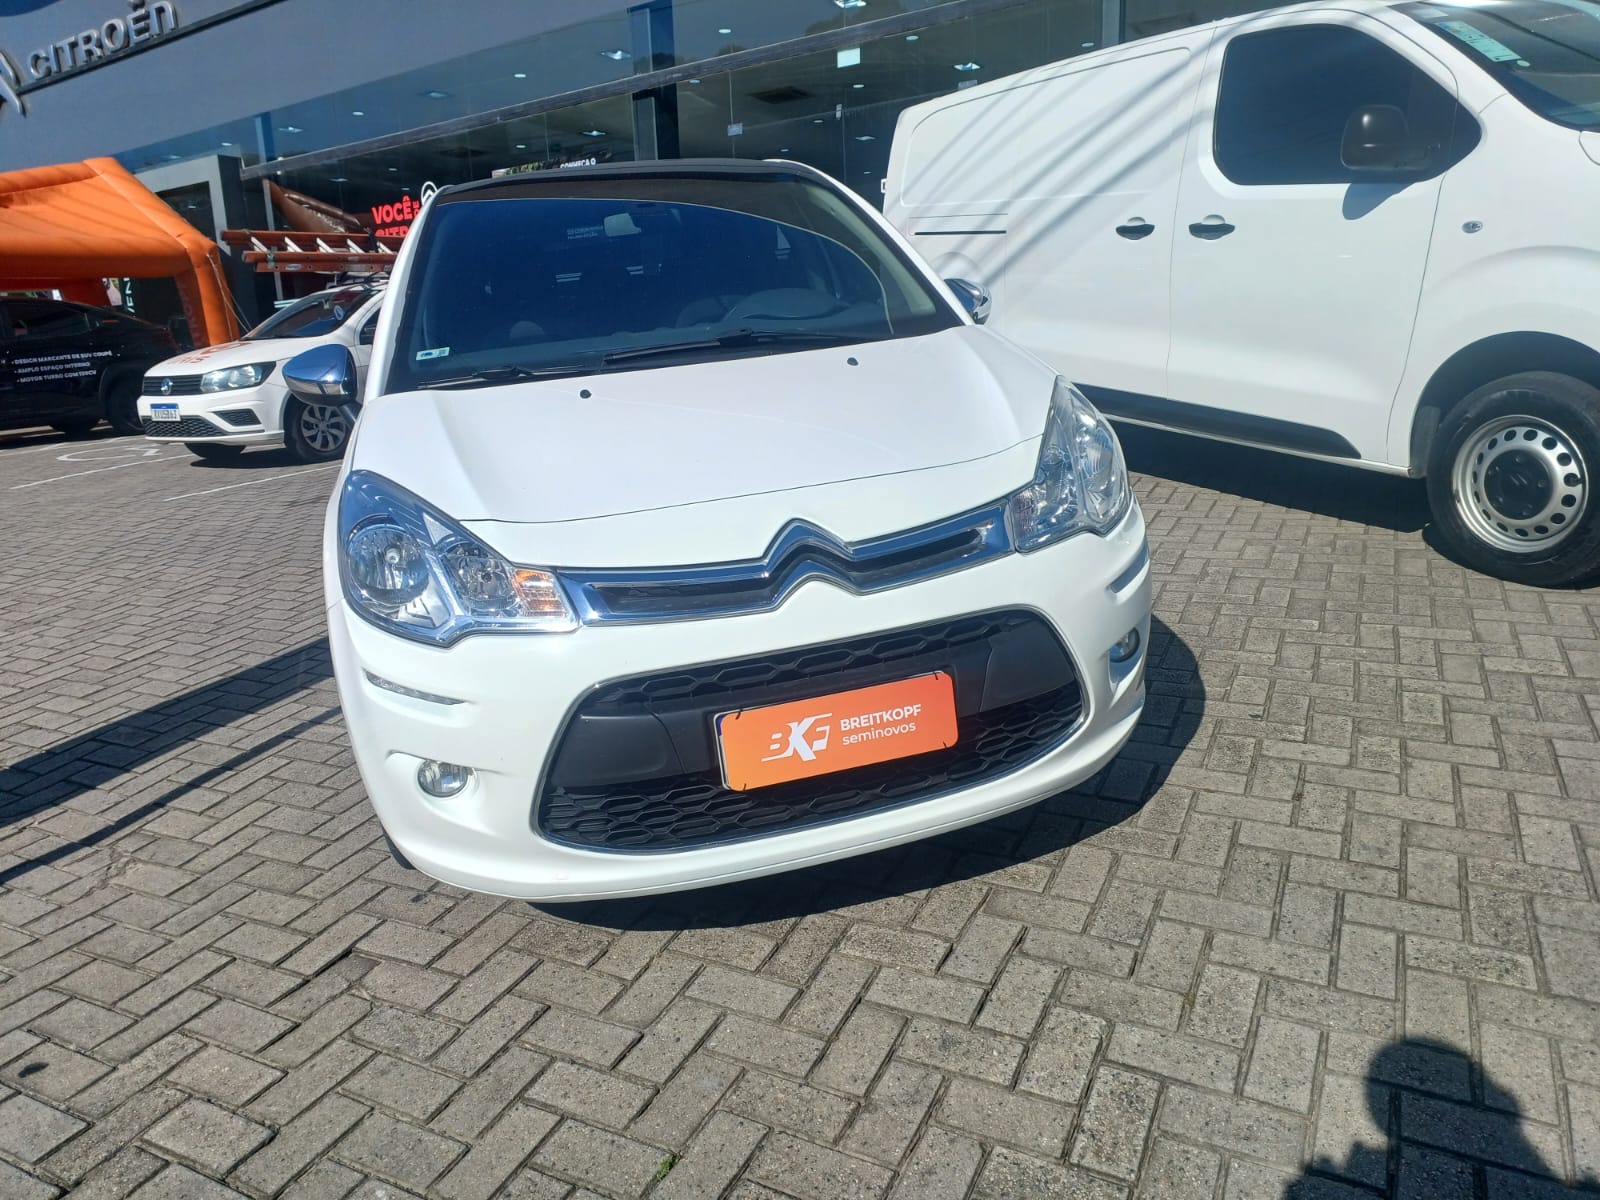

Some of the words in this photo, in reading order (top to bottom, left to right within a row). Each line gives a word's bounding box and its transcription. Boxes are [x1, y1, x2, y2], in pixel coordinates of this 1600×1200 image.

[371, 195, 413, 224] VOCÊ
[20, 375, 43, 383] MOTOR
[43, 373, 64, 381] TURBO
[40, 364, 64, 372] ESPAÇO
[840, 704, 922, 732] BREITKOPF
[842, 722, 916, 746] seminovos
